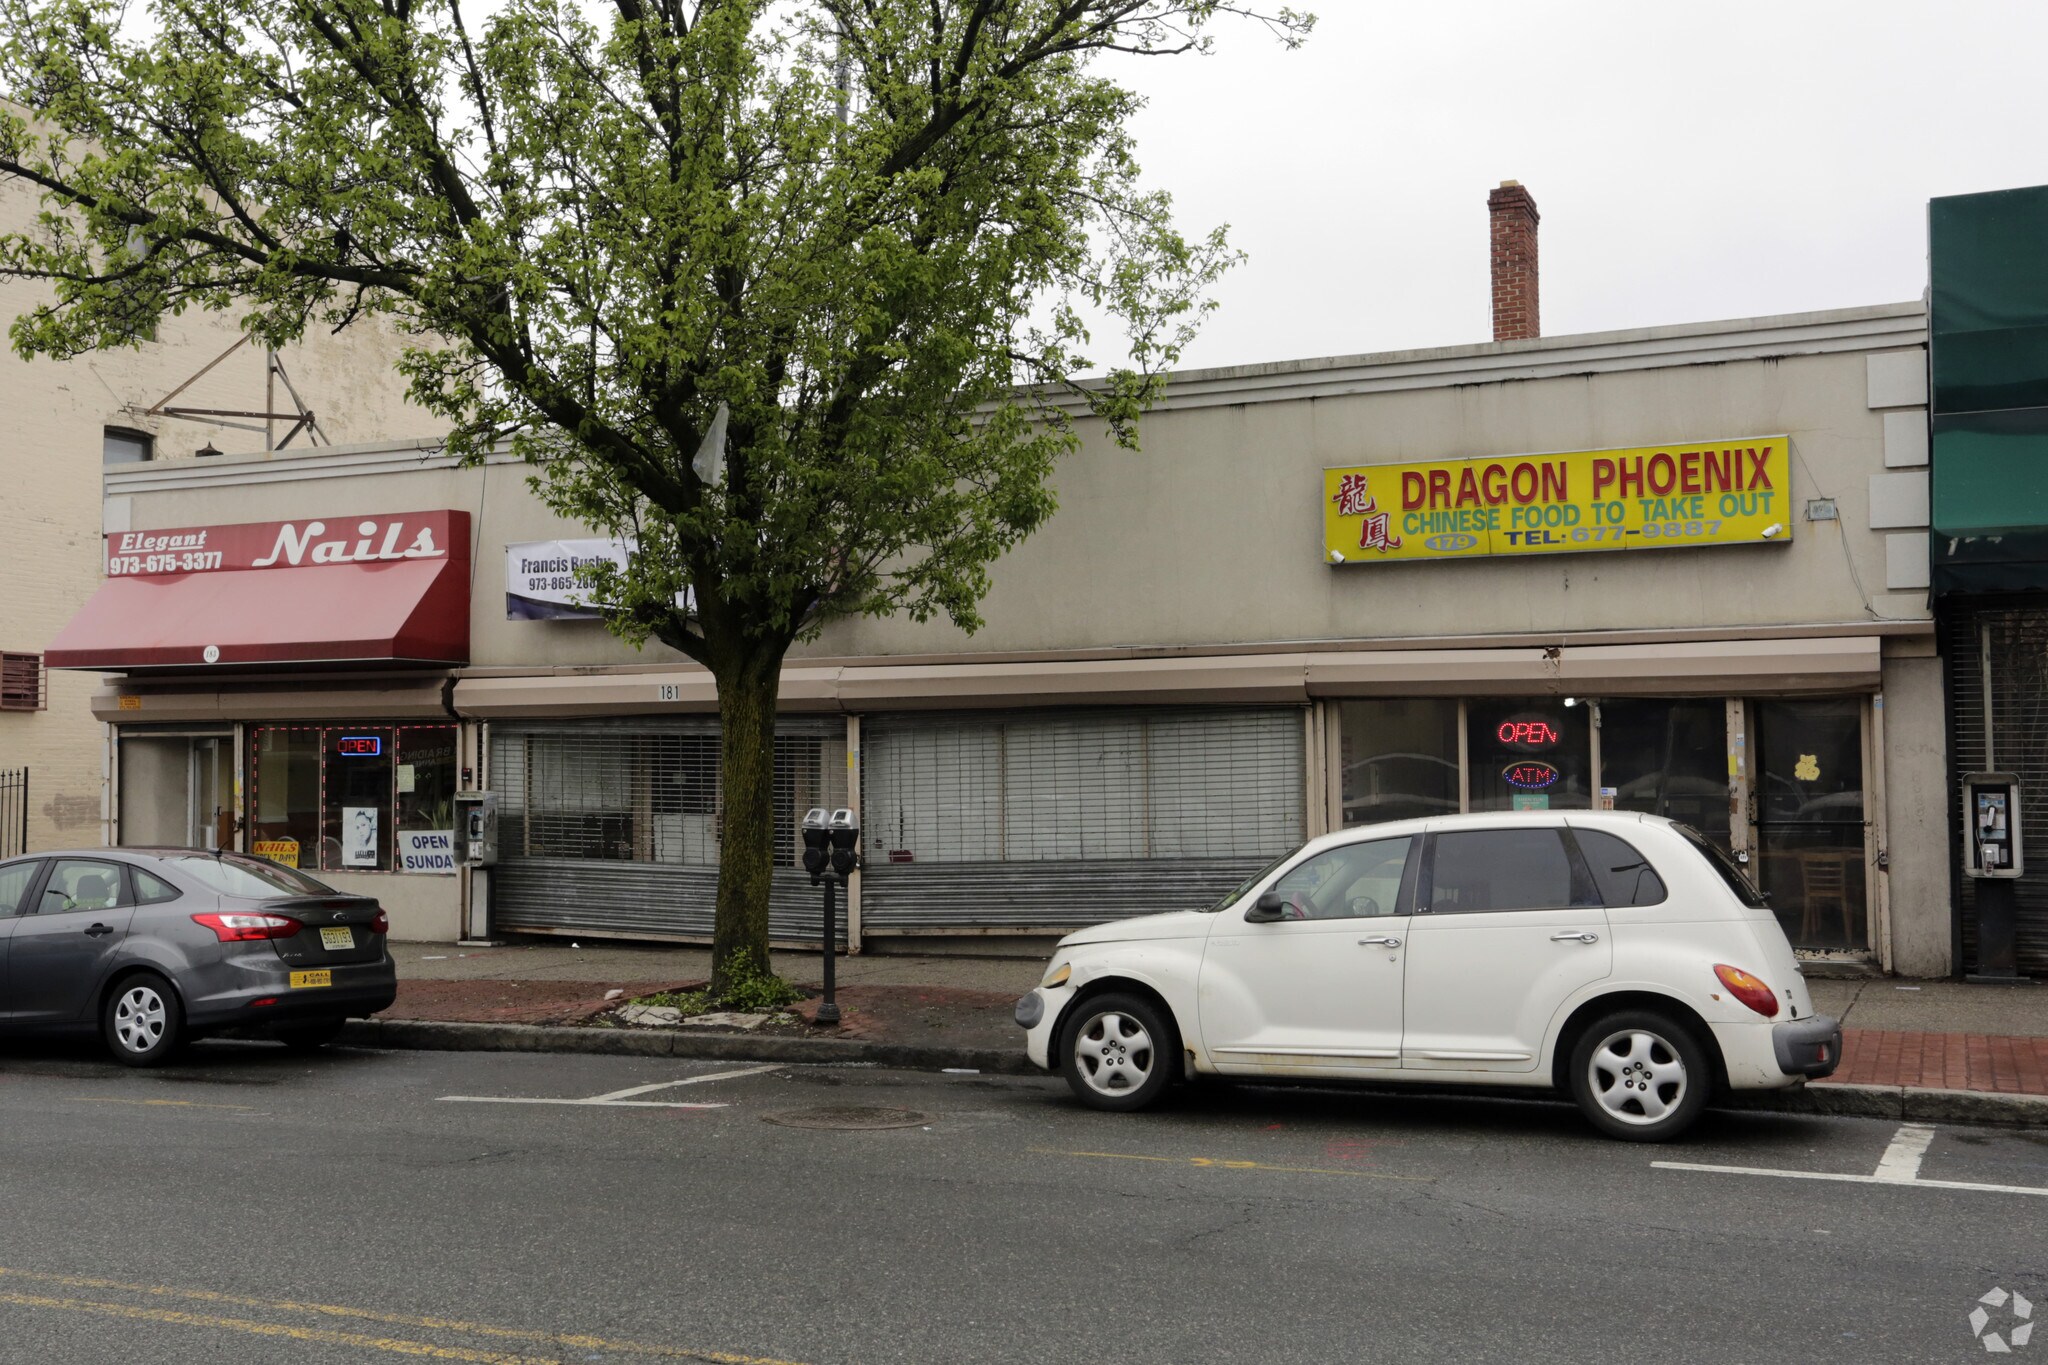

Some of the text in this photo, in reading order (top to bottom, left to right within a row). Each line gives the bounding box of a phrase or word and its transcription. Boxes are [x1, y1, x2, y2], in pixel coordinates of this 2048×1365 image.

[1402, 447, 1773, 511] DRAGON PHOENIX
[1332, 474, 1402, 552] 龍鳳
[1402, 492, 1775, 535] CHINESE FOOD TO TAKE OUT
[1571, 520, 1722, 543] 677-9887
[119, 530, 207, 552] Elegant
[251, 521, 445, 566] Nails
[1432, 536, 1469, 548] 179
[110, 551, 222, 575] 973-675-3377
[521, 557, 568, 574] Francis
[661, 685, 679, 700] 181
[1498, 722, 1557, 743] OPEN
[337, 740, 376, 752] OPEN
[1511, 767, 1550, 783] ATM
[256, 842, 298, 852] NAILS
[412, 835, 449, 849] OPEN
[279, 853, 297, 862] DAYS
[406, 855, 455, 869] SUNDA
